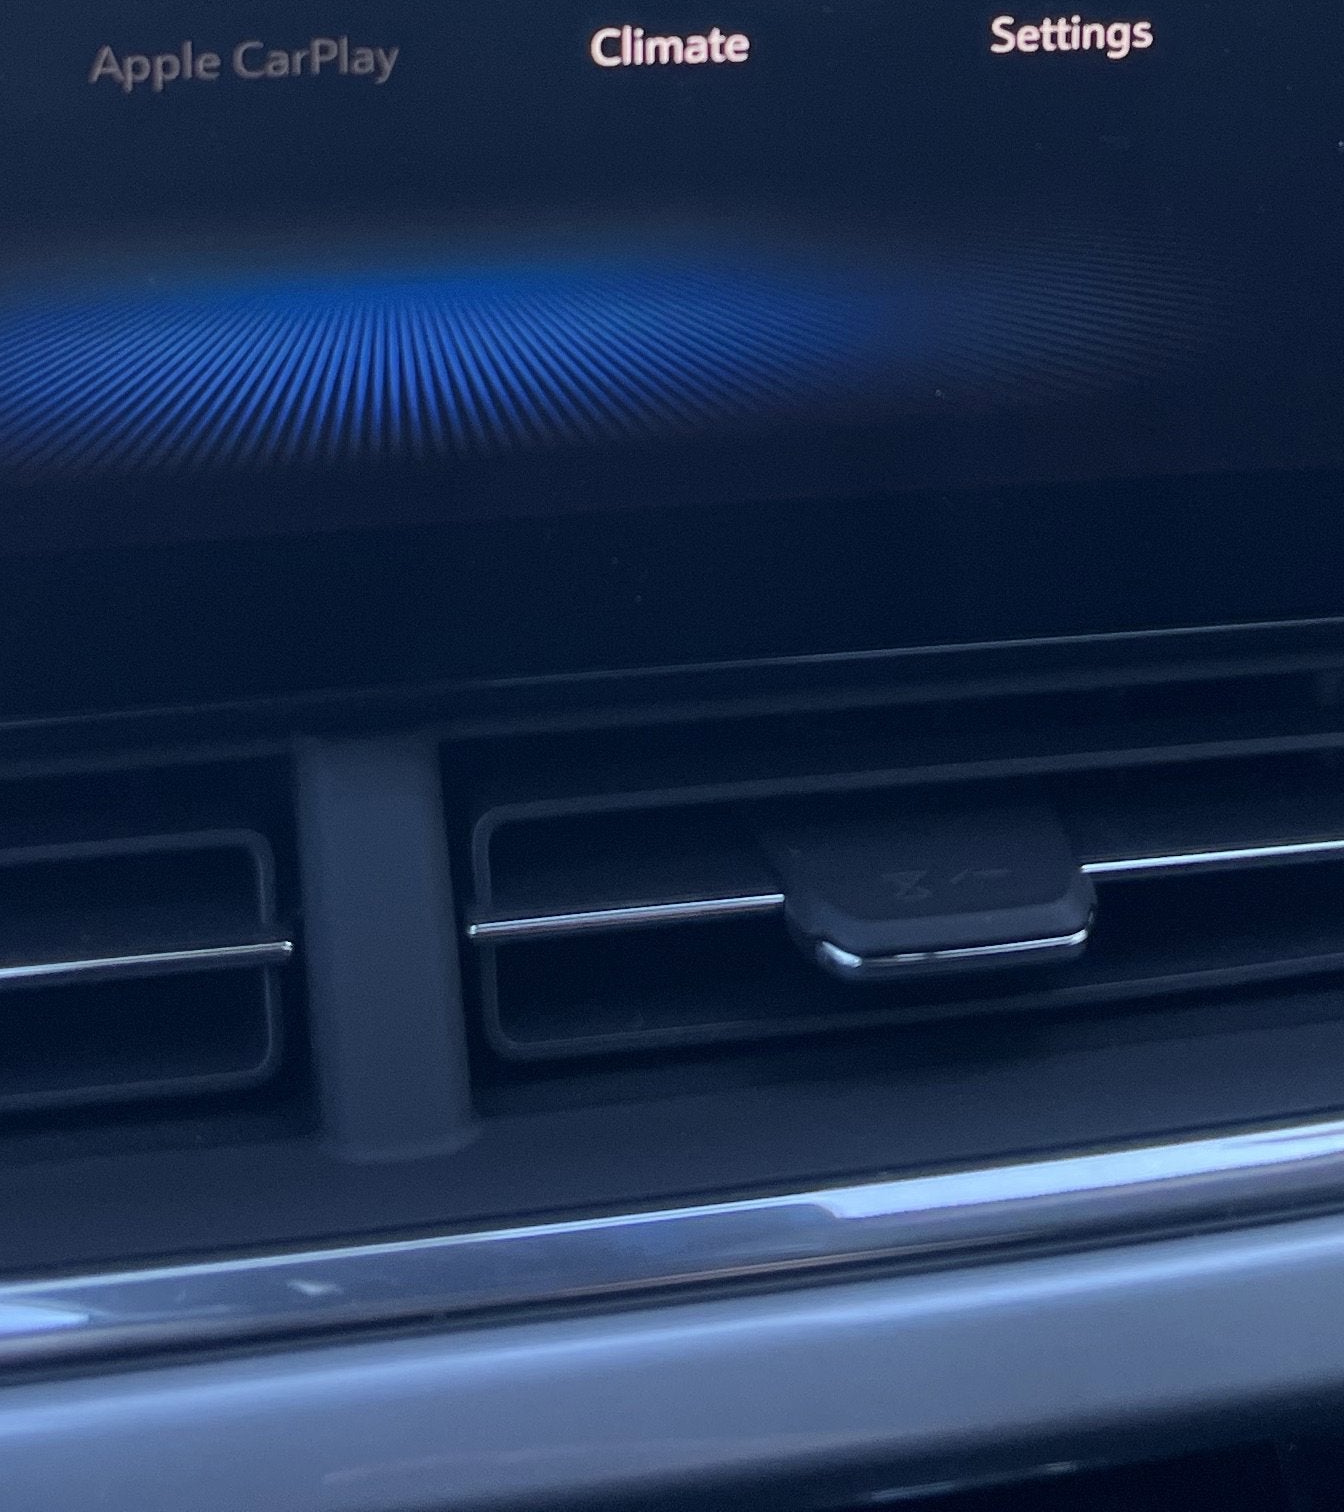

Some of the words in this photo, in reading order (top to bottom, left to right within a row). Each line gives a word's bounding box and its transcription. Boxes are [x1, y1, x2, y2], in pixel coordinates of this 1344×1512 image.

[589, 24, 751, 68] Climate
[989, 14, 1154, 61] Settings
[89, 39, 221, 93] Apple
[231, 34, 401, 84] CarPlay
